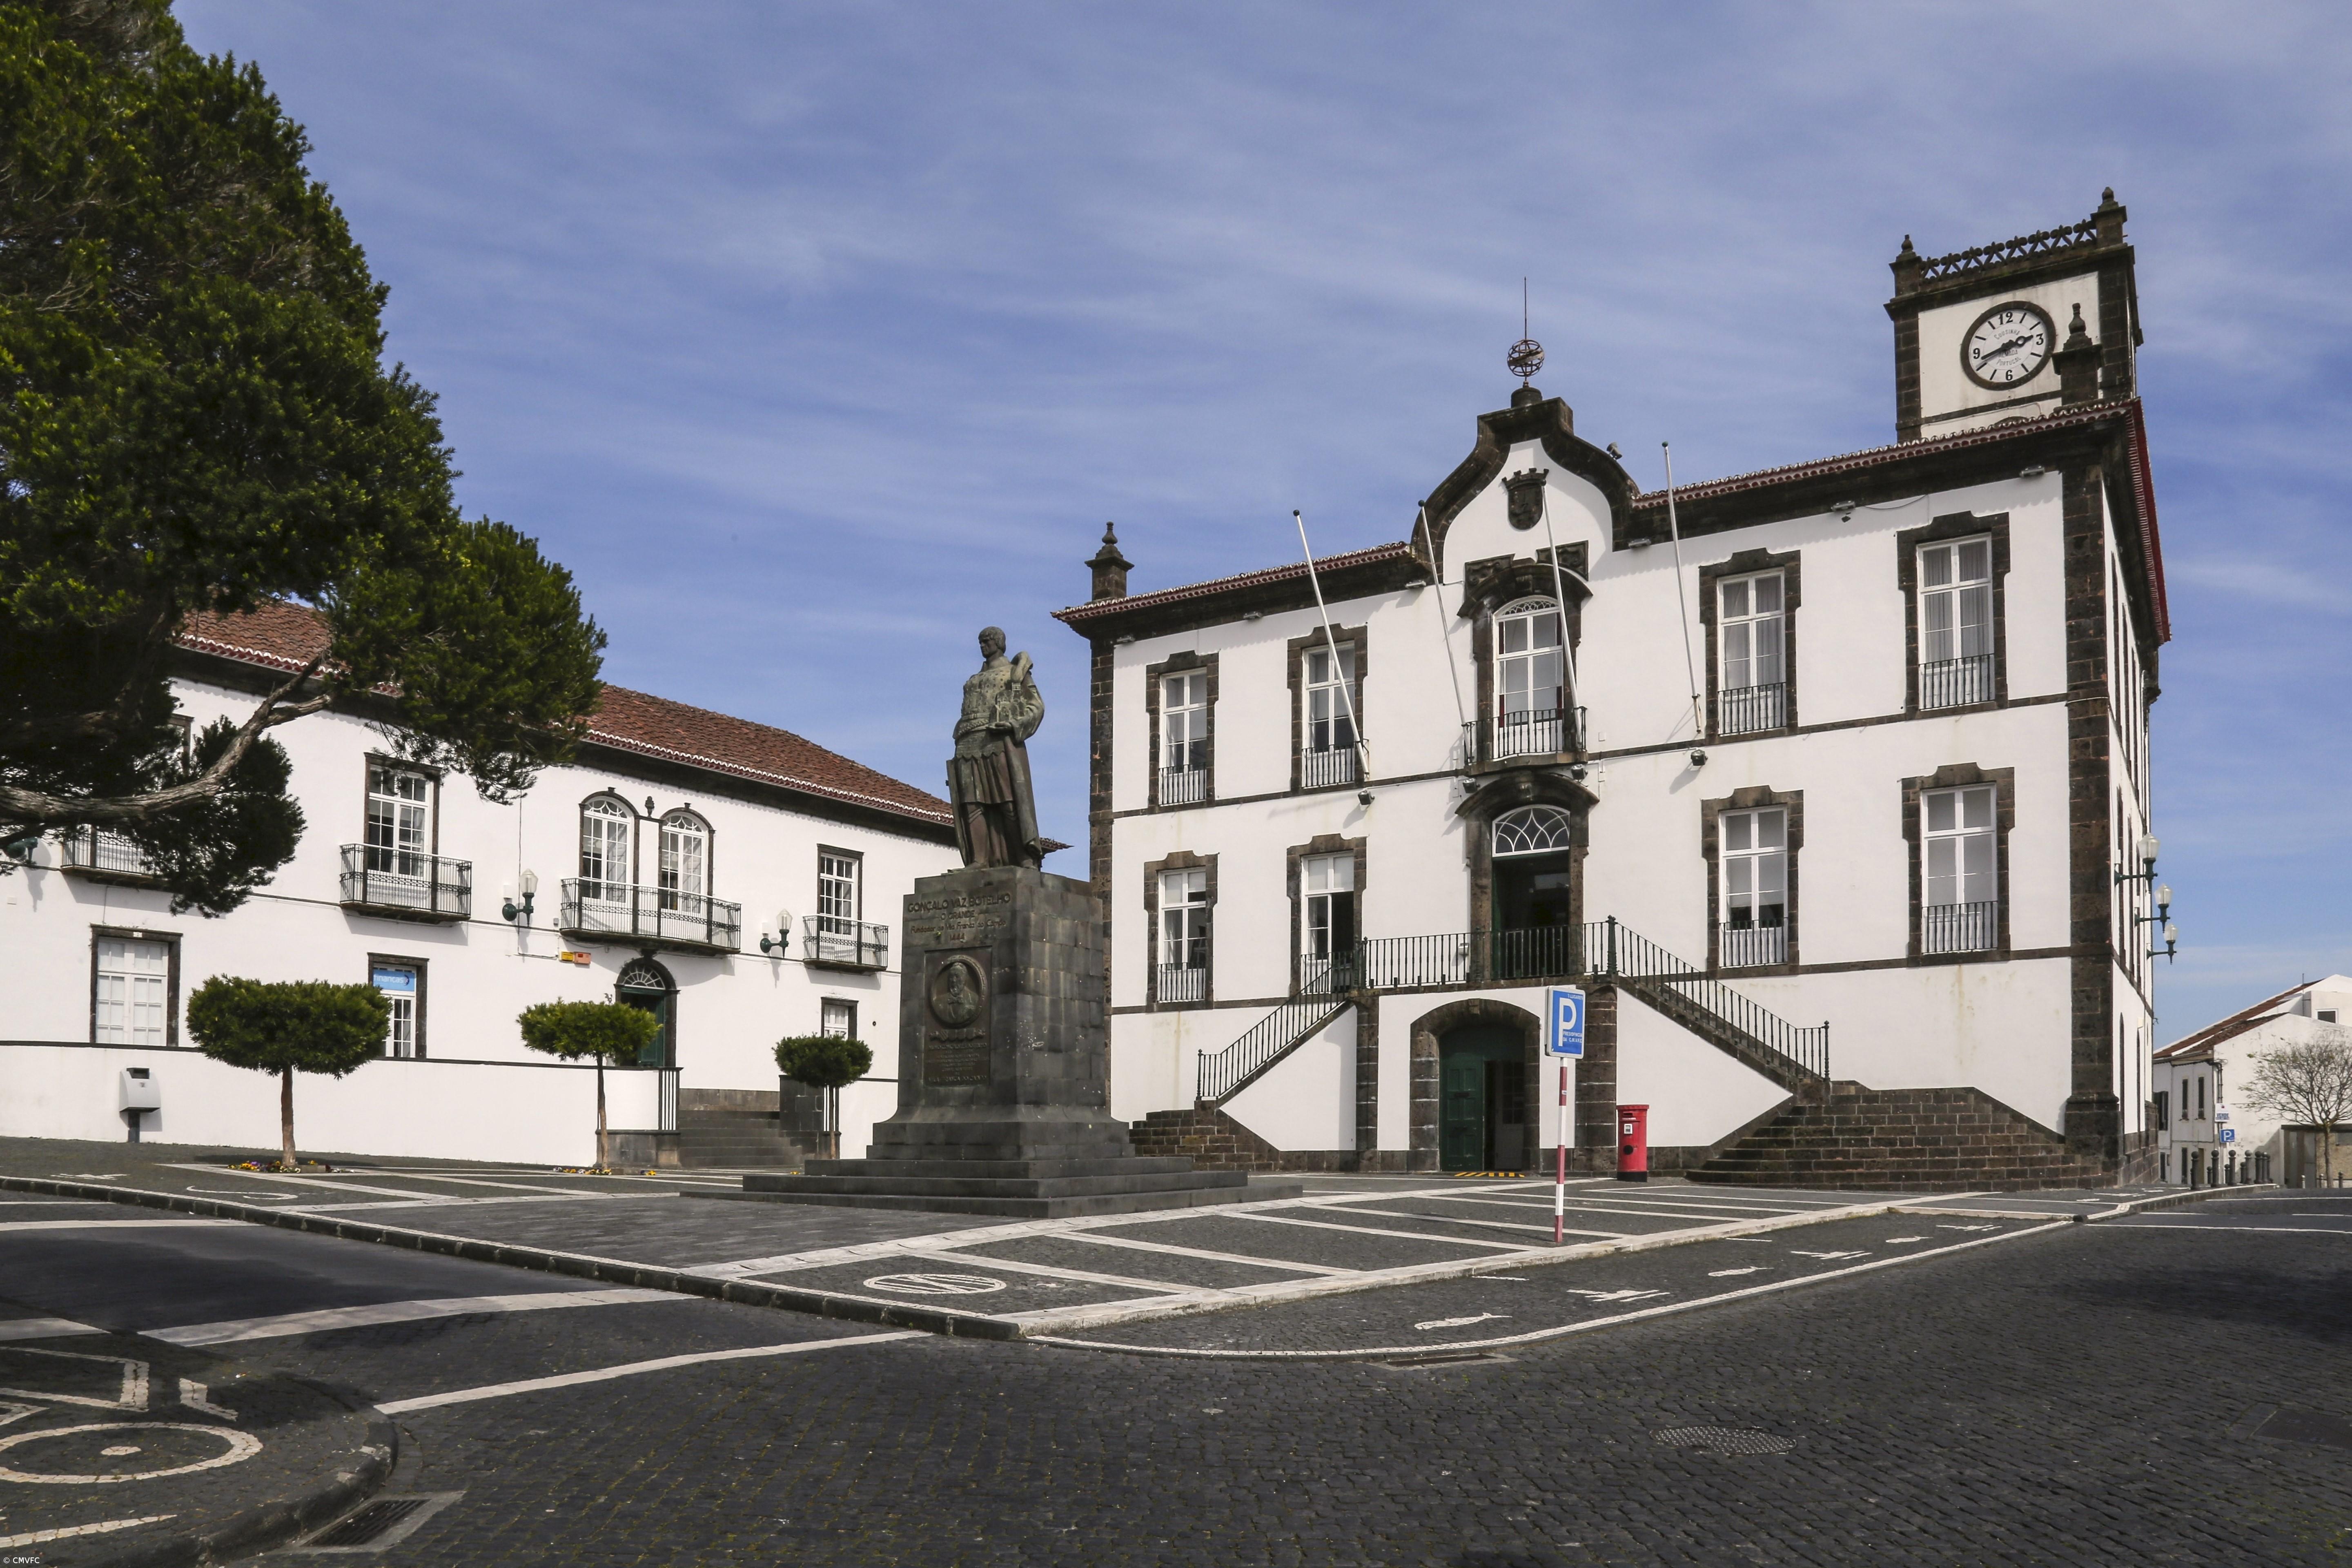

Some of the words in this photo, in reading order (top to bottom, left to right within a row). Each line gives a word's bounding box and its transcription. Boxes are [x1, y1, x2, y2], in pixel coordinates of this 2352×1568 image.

[1998, 312, 2013, 325] 12
[2036, 333, 2044, 345] 3
[1973, 348, 1980, 359] 9
[1996, 356, 2022, 366] PORTUGAL
[2005, 370, 2013, 381] 6
[907, 900, 949, 913] GONÇALO
[952, 897, 967, 908] VAZ
[969, 893, 1011, 907] BOTELHO
[948, 910, 975, 920] GRANDE
[986, 919, 1007, 928] Campo
[1558, 998, 1577, 1047] P
[2224, 1130, 2232, 1141] P
